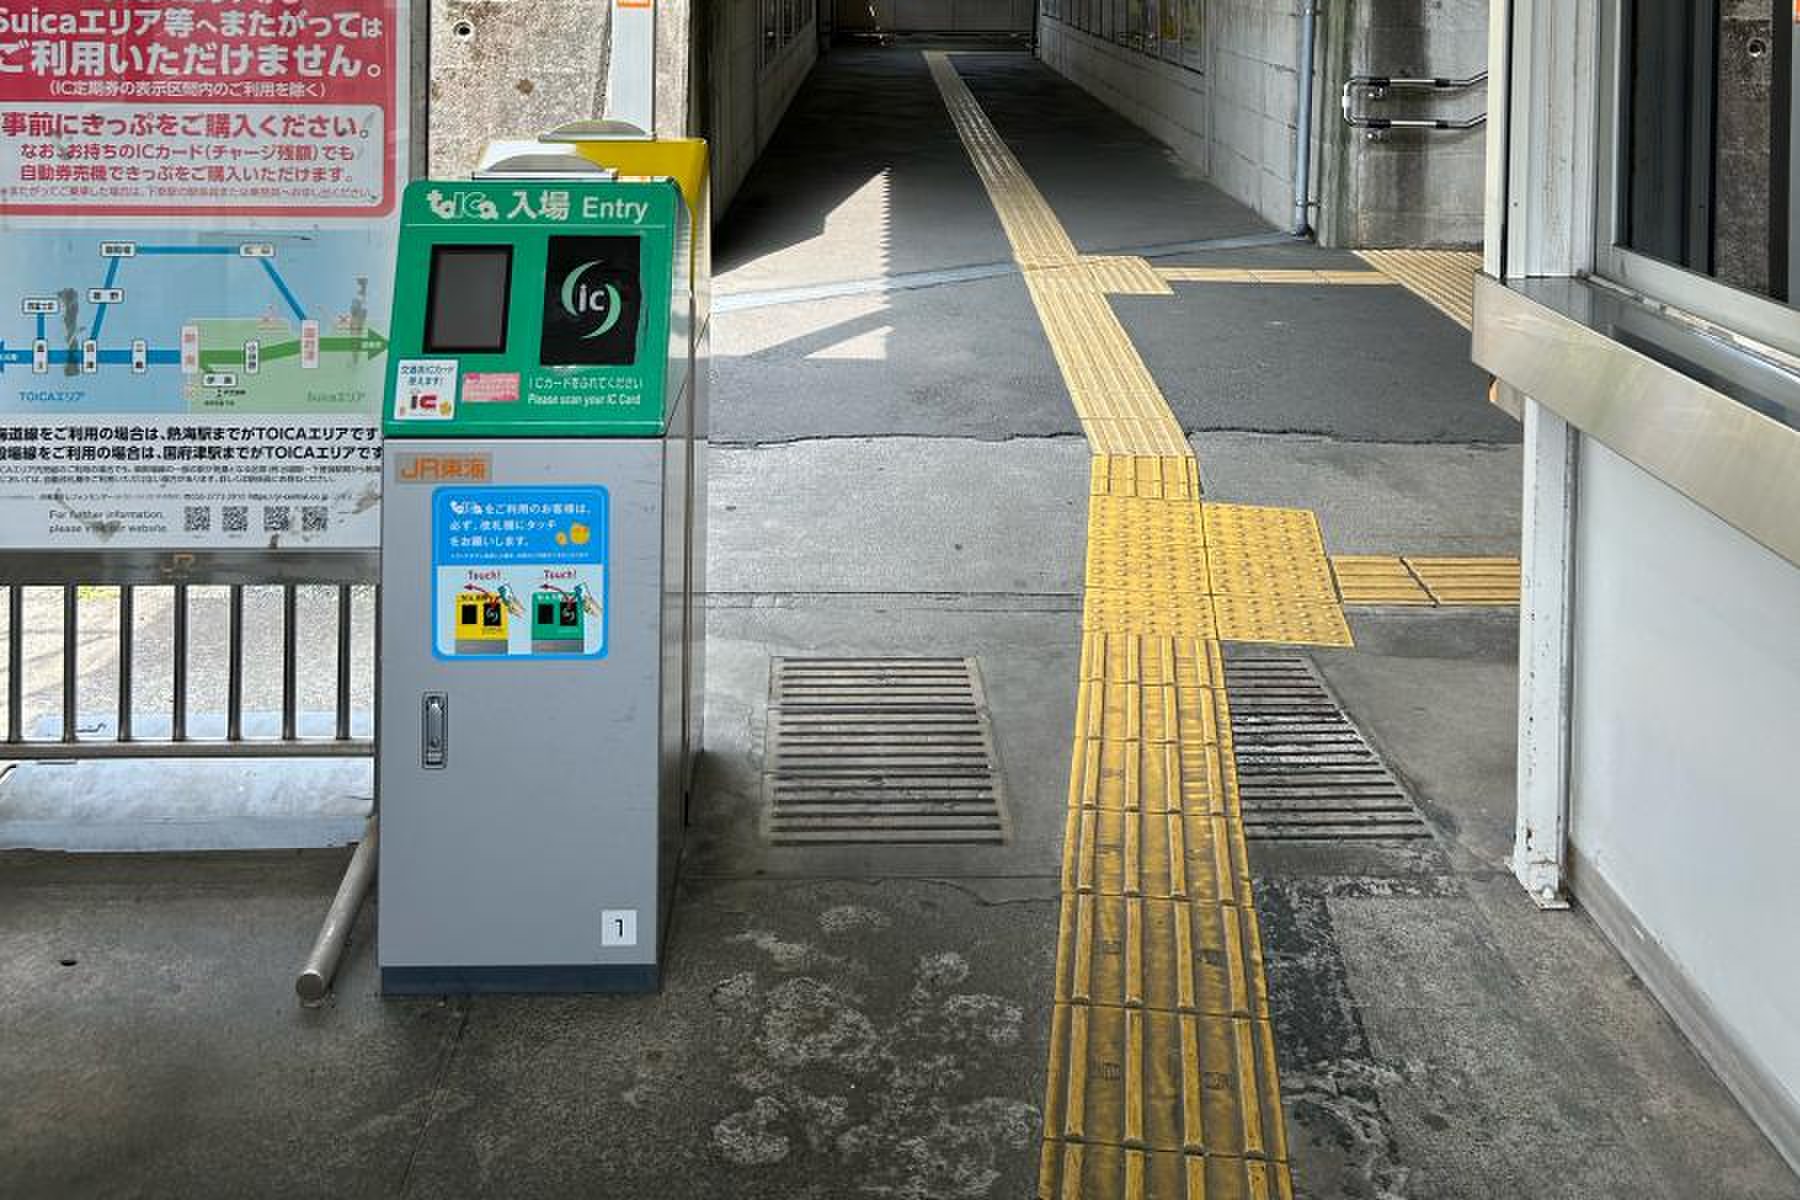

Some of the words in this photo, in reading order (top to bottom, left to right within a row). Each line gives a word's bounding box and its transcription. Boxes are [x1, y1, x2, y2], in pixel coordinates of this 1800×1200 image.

[0, 39, 383, 78] ご利用いただけません。
[2, 111, 369, 138] 事前にきっぷをご購入ください。
[506, 189, 572, 221] 入場
[582, 195, 649, 224] Entry
[402, 456, 487, 480] JR東海
[614, 918, 623, 938] 1
